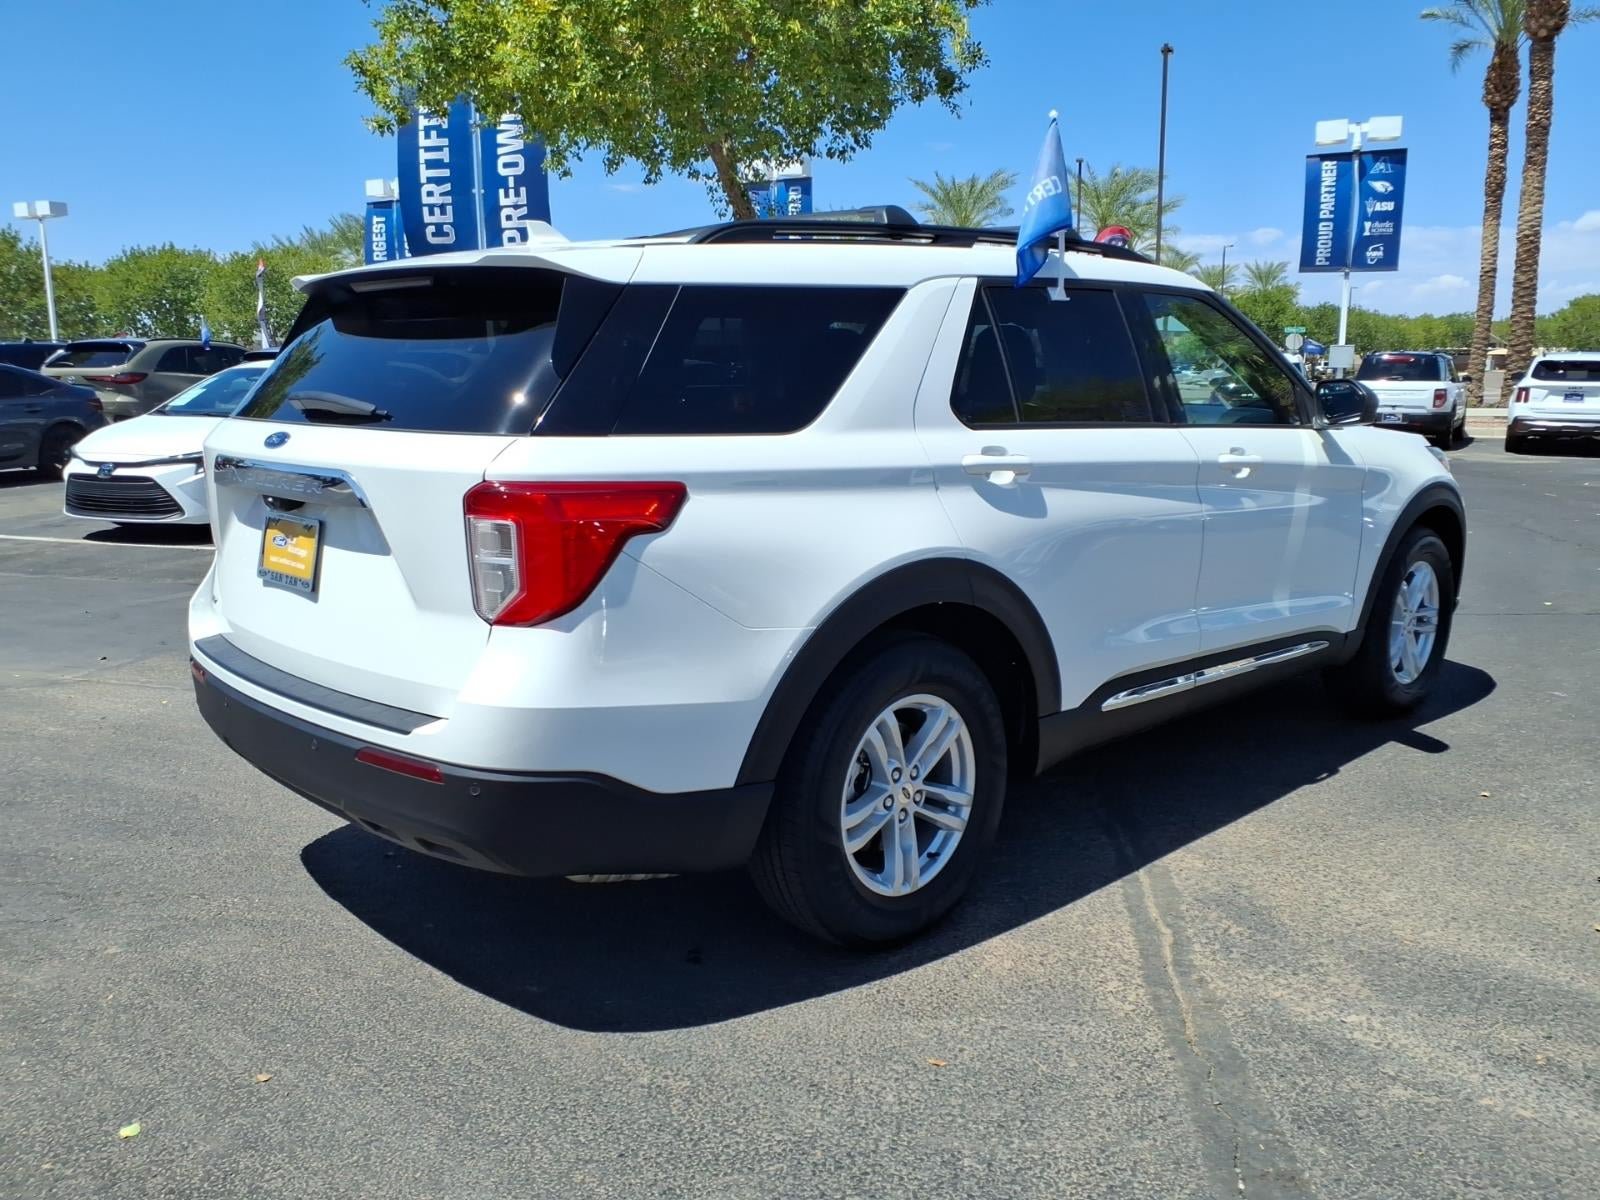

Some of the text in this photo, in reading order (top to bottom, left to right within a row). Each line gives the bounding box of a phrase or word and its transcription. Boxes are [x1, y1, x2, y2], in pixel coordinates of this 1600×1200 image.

[418, 101, 456, 245] CERTIFI
[1315, 160, 1338, 266] PROUD PARTNER
[1374, 201, 1395, 211] ASU
